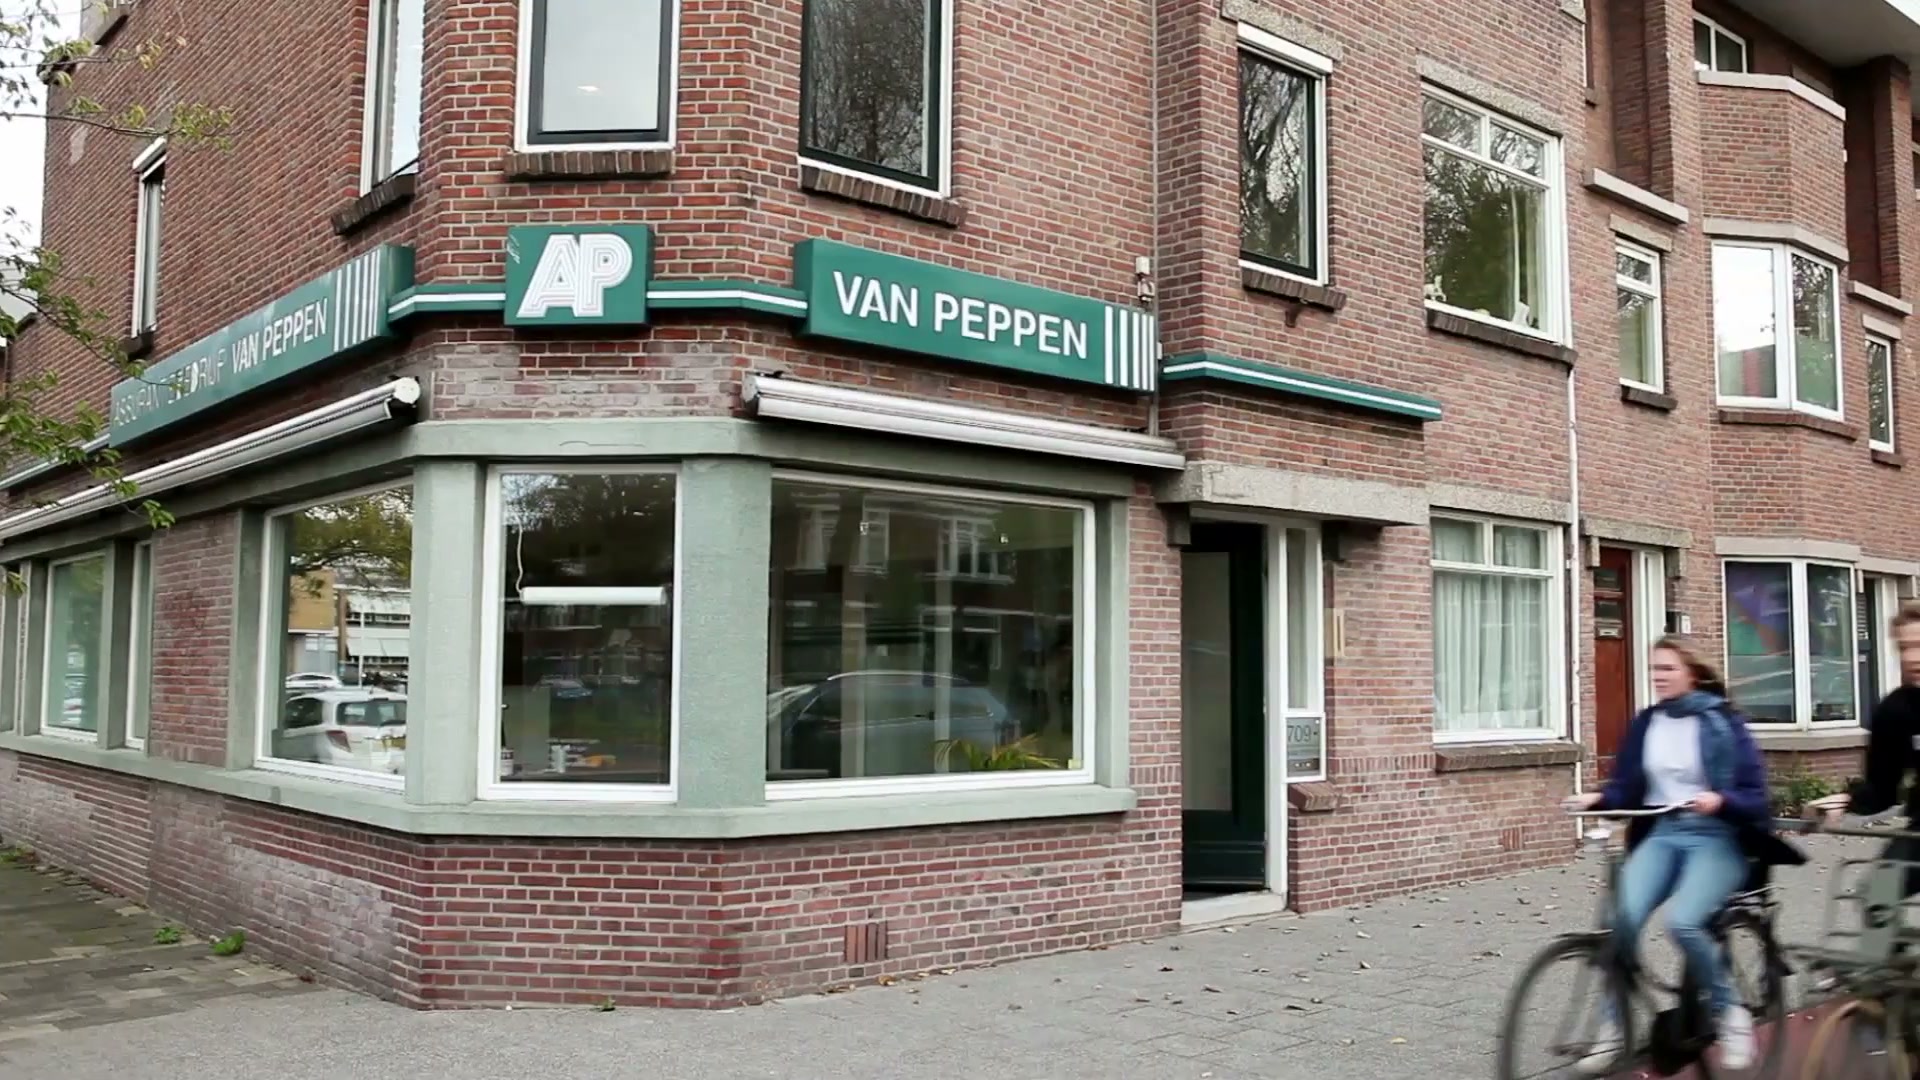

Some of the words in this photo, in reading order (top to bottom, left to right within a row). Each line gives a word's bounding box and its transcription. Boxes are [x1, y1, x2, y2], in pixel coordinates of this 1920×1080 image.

[516, 233, 633, 318] AP
[833, 271, 919, 328] VAN
[934, 292, 1088, 359] PEPPEN
[232, 331, 259, 374] VAN
[262, 297, 328, 361] PEPPEN
